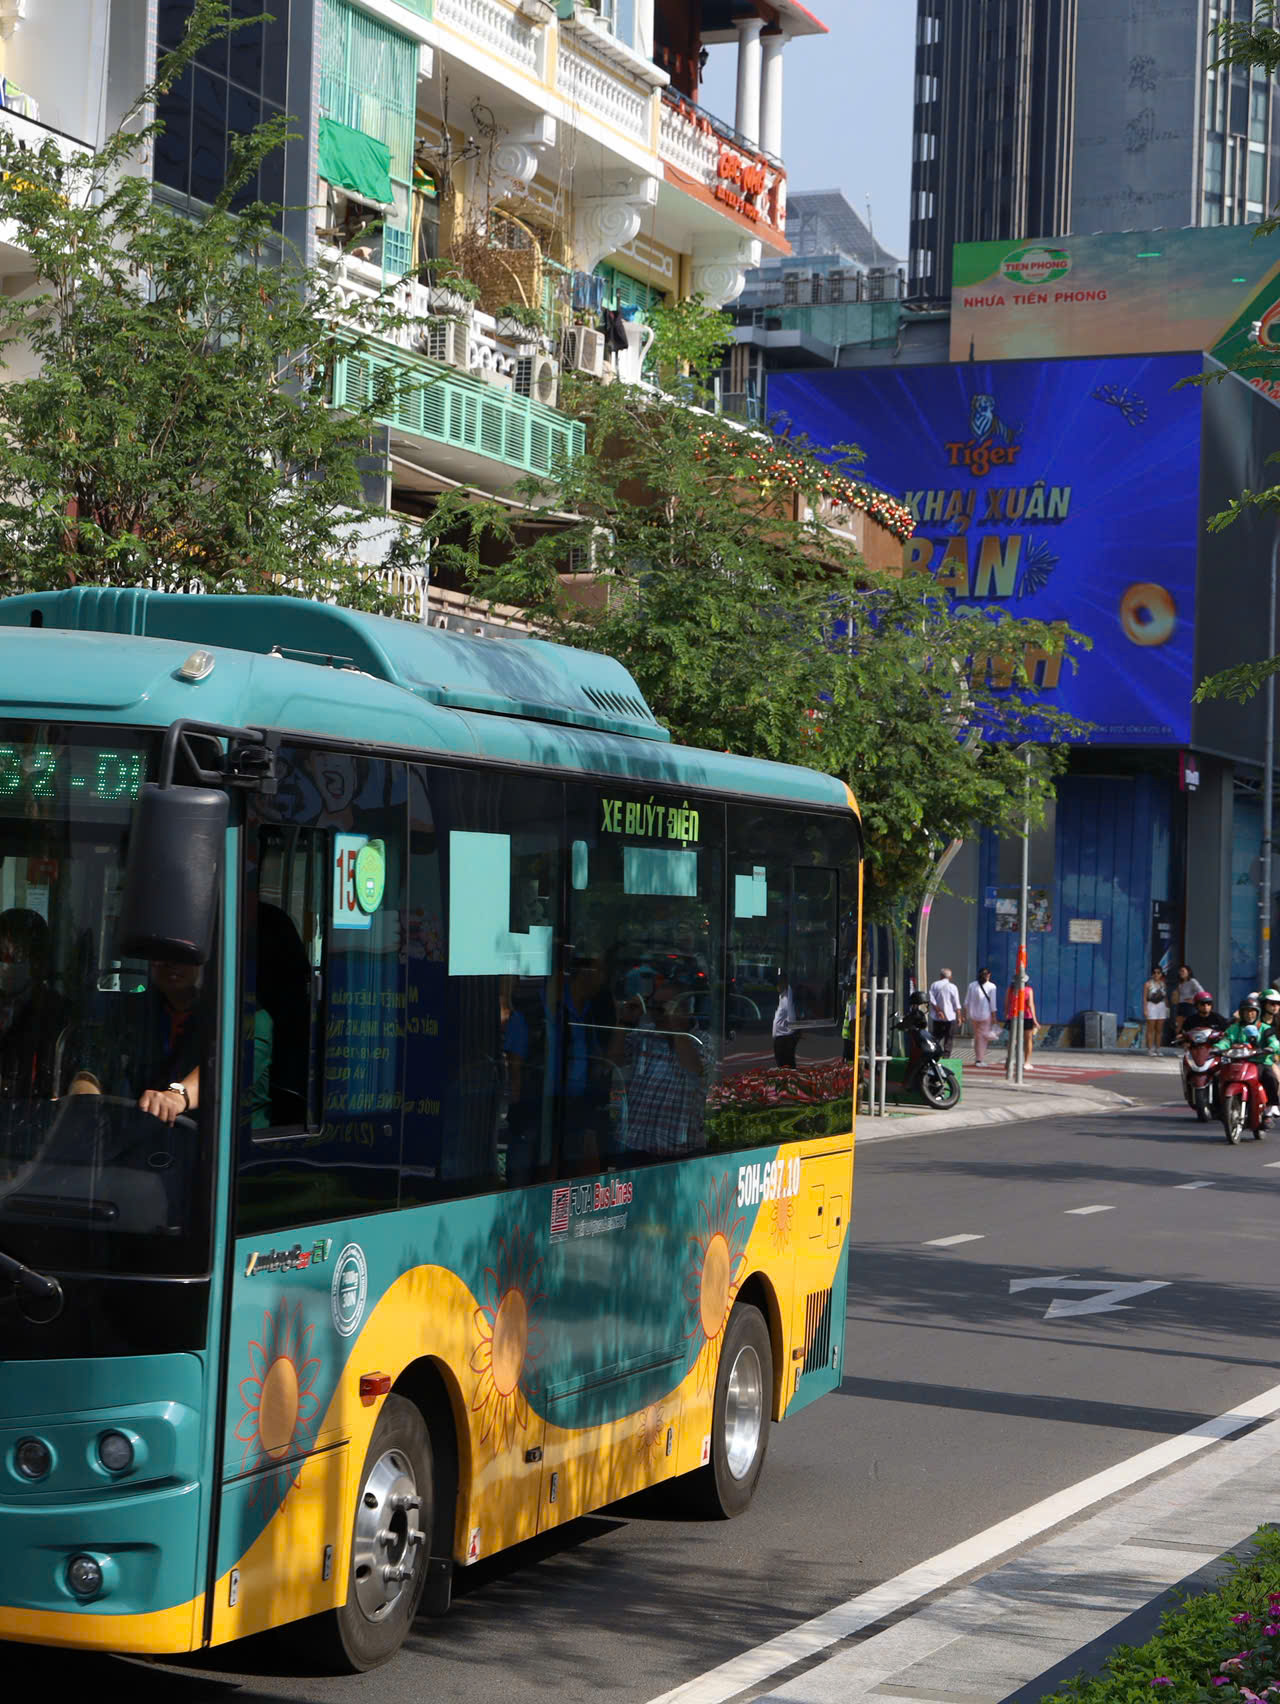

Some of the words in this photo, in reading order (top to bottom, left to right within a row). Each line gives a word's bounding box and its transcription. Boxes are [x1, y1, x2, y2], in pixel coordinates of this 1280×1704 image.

[1030, 258, 1068, 272] PHONG
[1054, 289, 1108, 304] PHONG
[944, 439, 1021, 477] Tiger
[904, 487, 977, 522] KHAI
[983, 479, 1072, 521] XUÂN
[32, 751, 57, 797] 2
[600, 799, 623, 833] XE
[625, 795, 666, 838] BUÝT
[336, 848, 357, 912] 15
[593, 1181, 610, 1212] Bus
[610, 1178, 633, 1208] Lines
[737, 1157, 801, 1209] 50H-697.10
